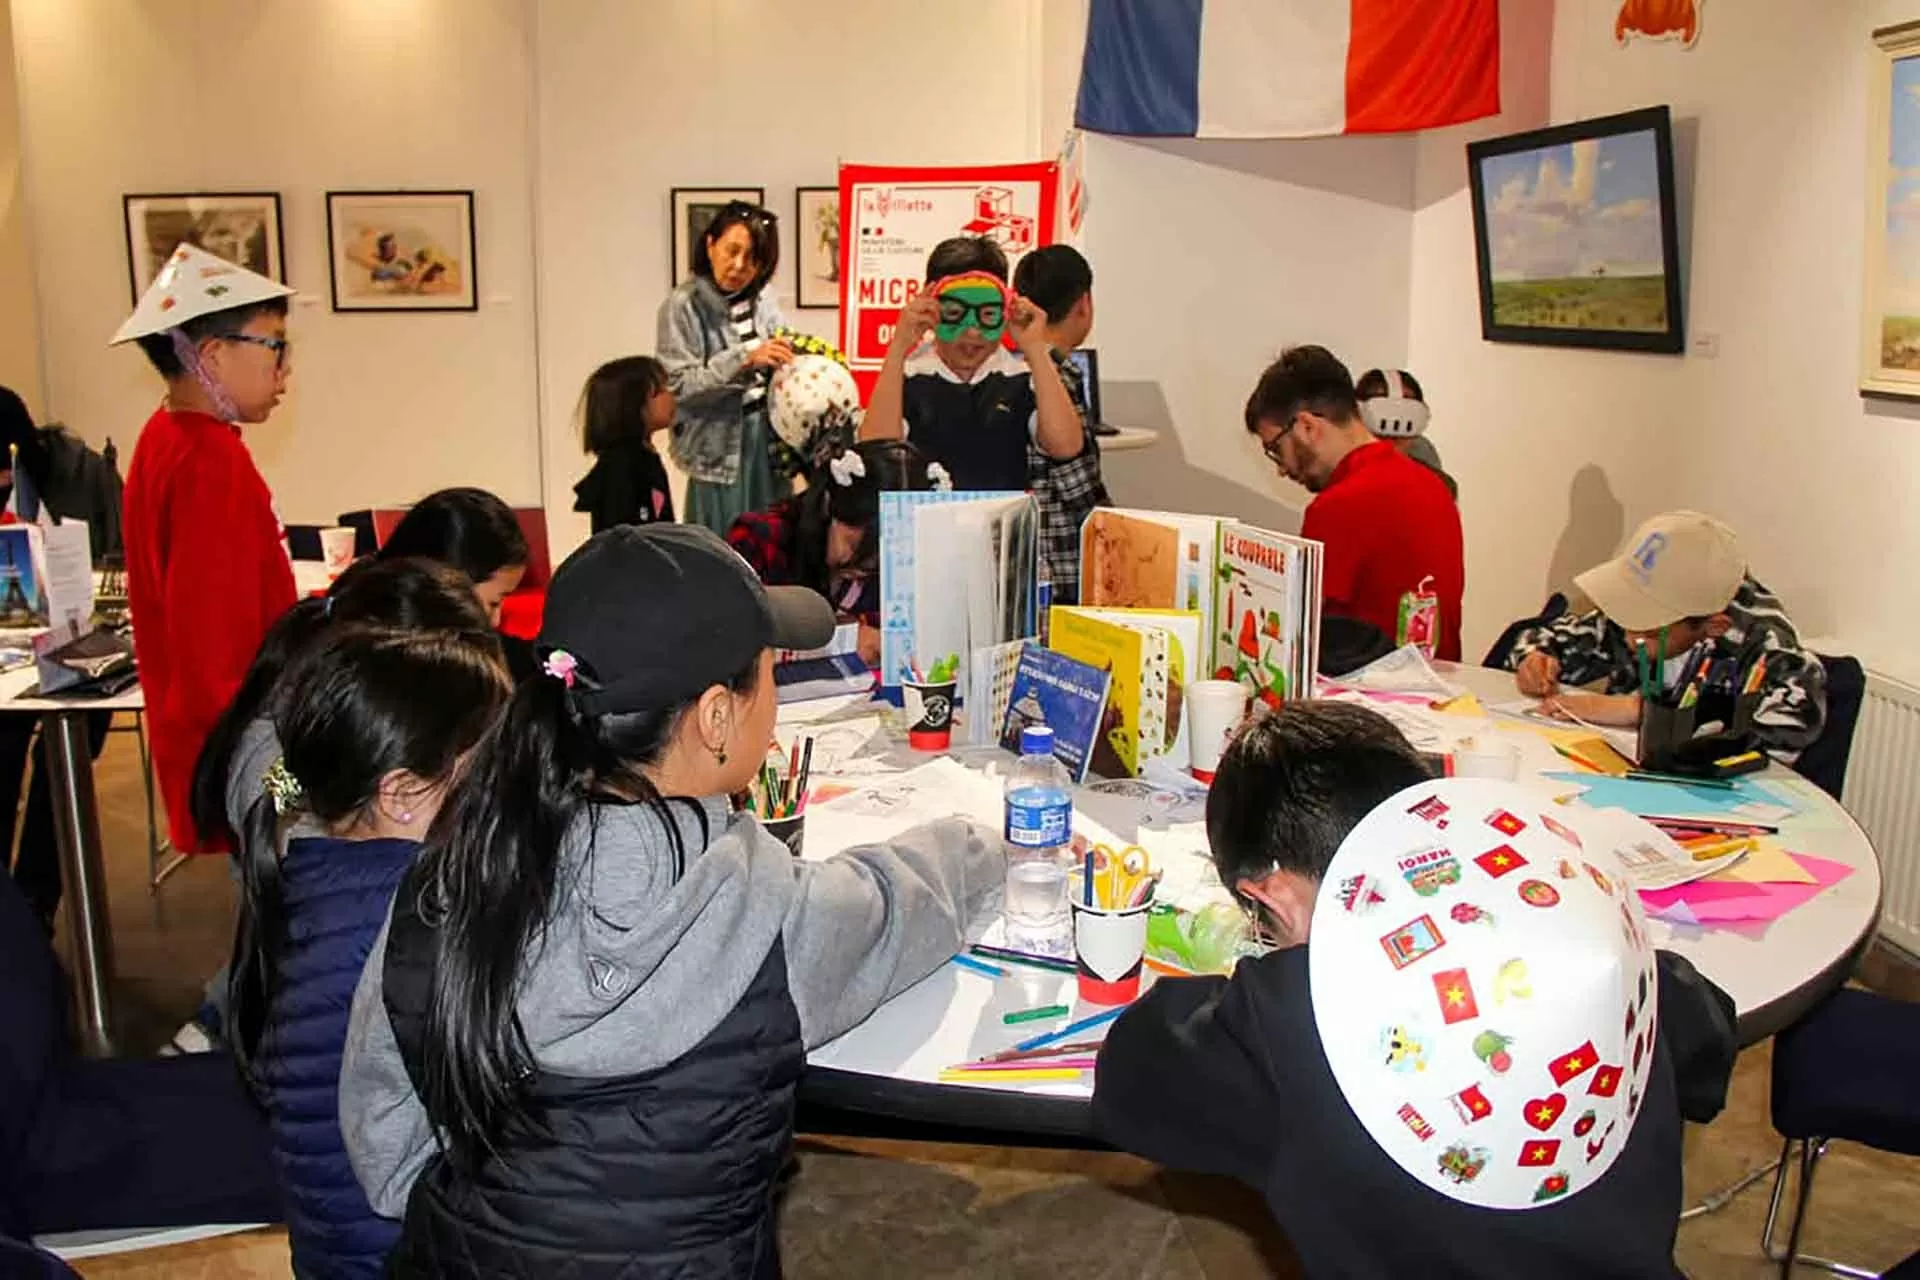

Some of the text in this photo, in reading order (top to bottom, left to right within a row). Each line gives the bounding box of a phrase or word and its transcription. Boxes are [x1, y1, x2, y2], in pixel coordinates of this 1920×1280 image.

[1223, 532, 1285, 576] LE COUPABLE
[1397, 848, 1452, 871] HANOI
